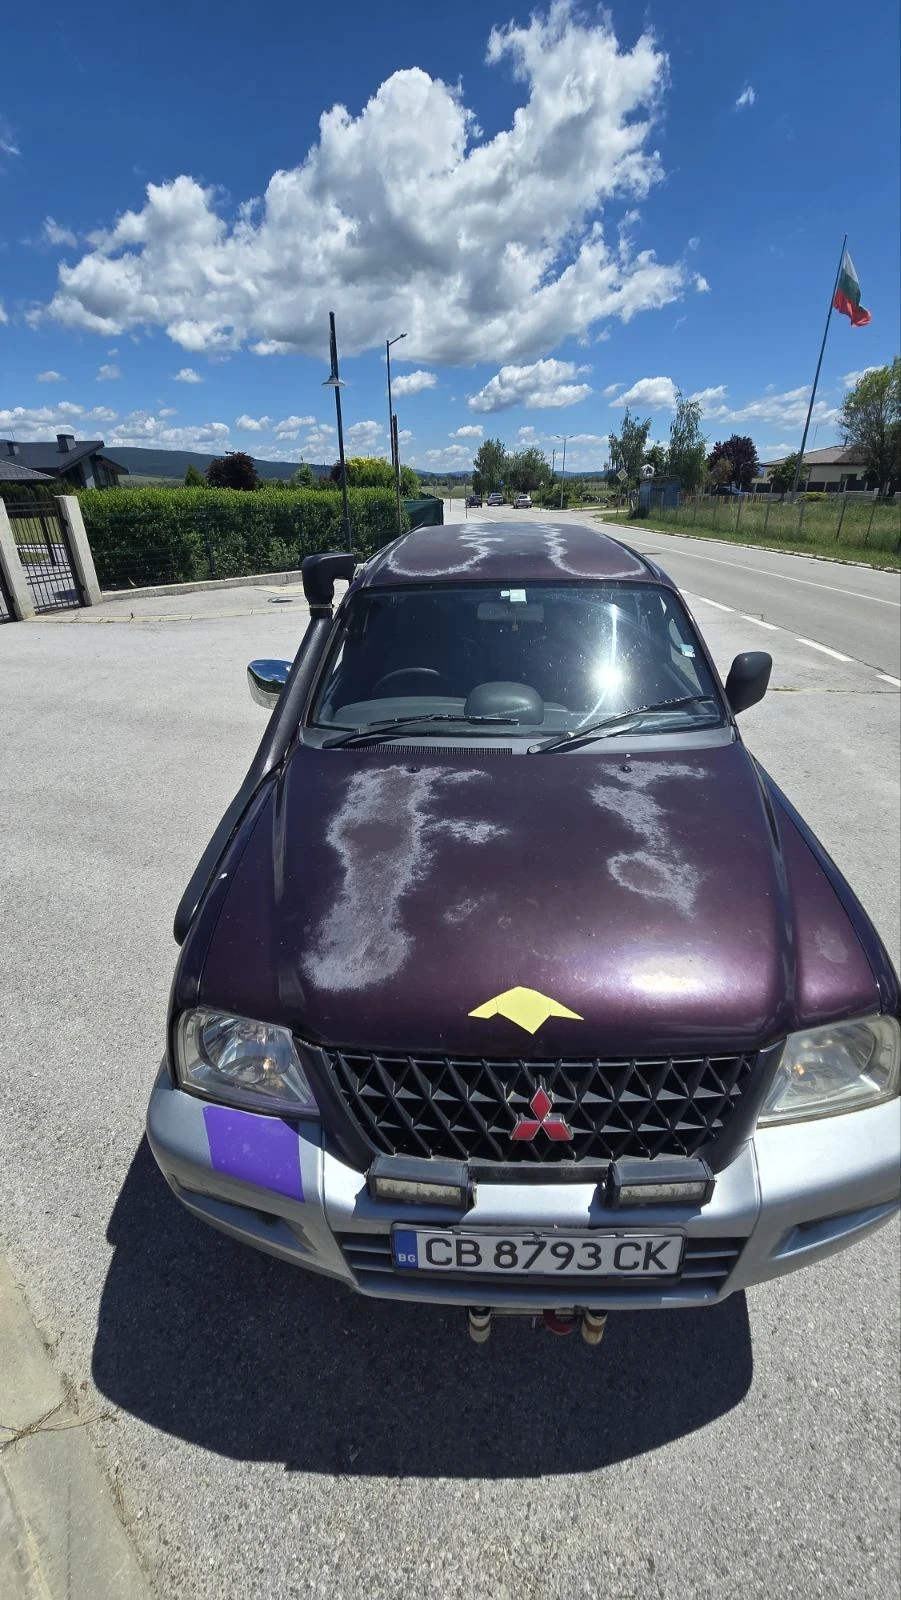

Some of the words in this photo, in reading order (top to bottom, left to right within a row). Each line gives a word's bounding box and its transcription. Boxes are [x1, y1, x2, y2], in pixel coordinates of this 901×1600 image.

[398, 1253, 416, 1263] BG
[425, 1238, 482, 1267] CB
[493, 1240, 602, 1271] 8793
[613, 1240, 671, 1270] CK
